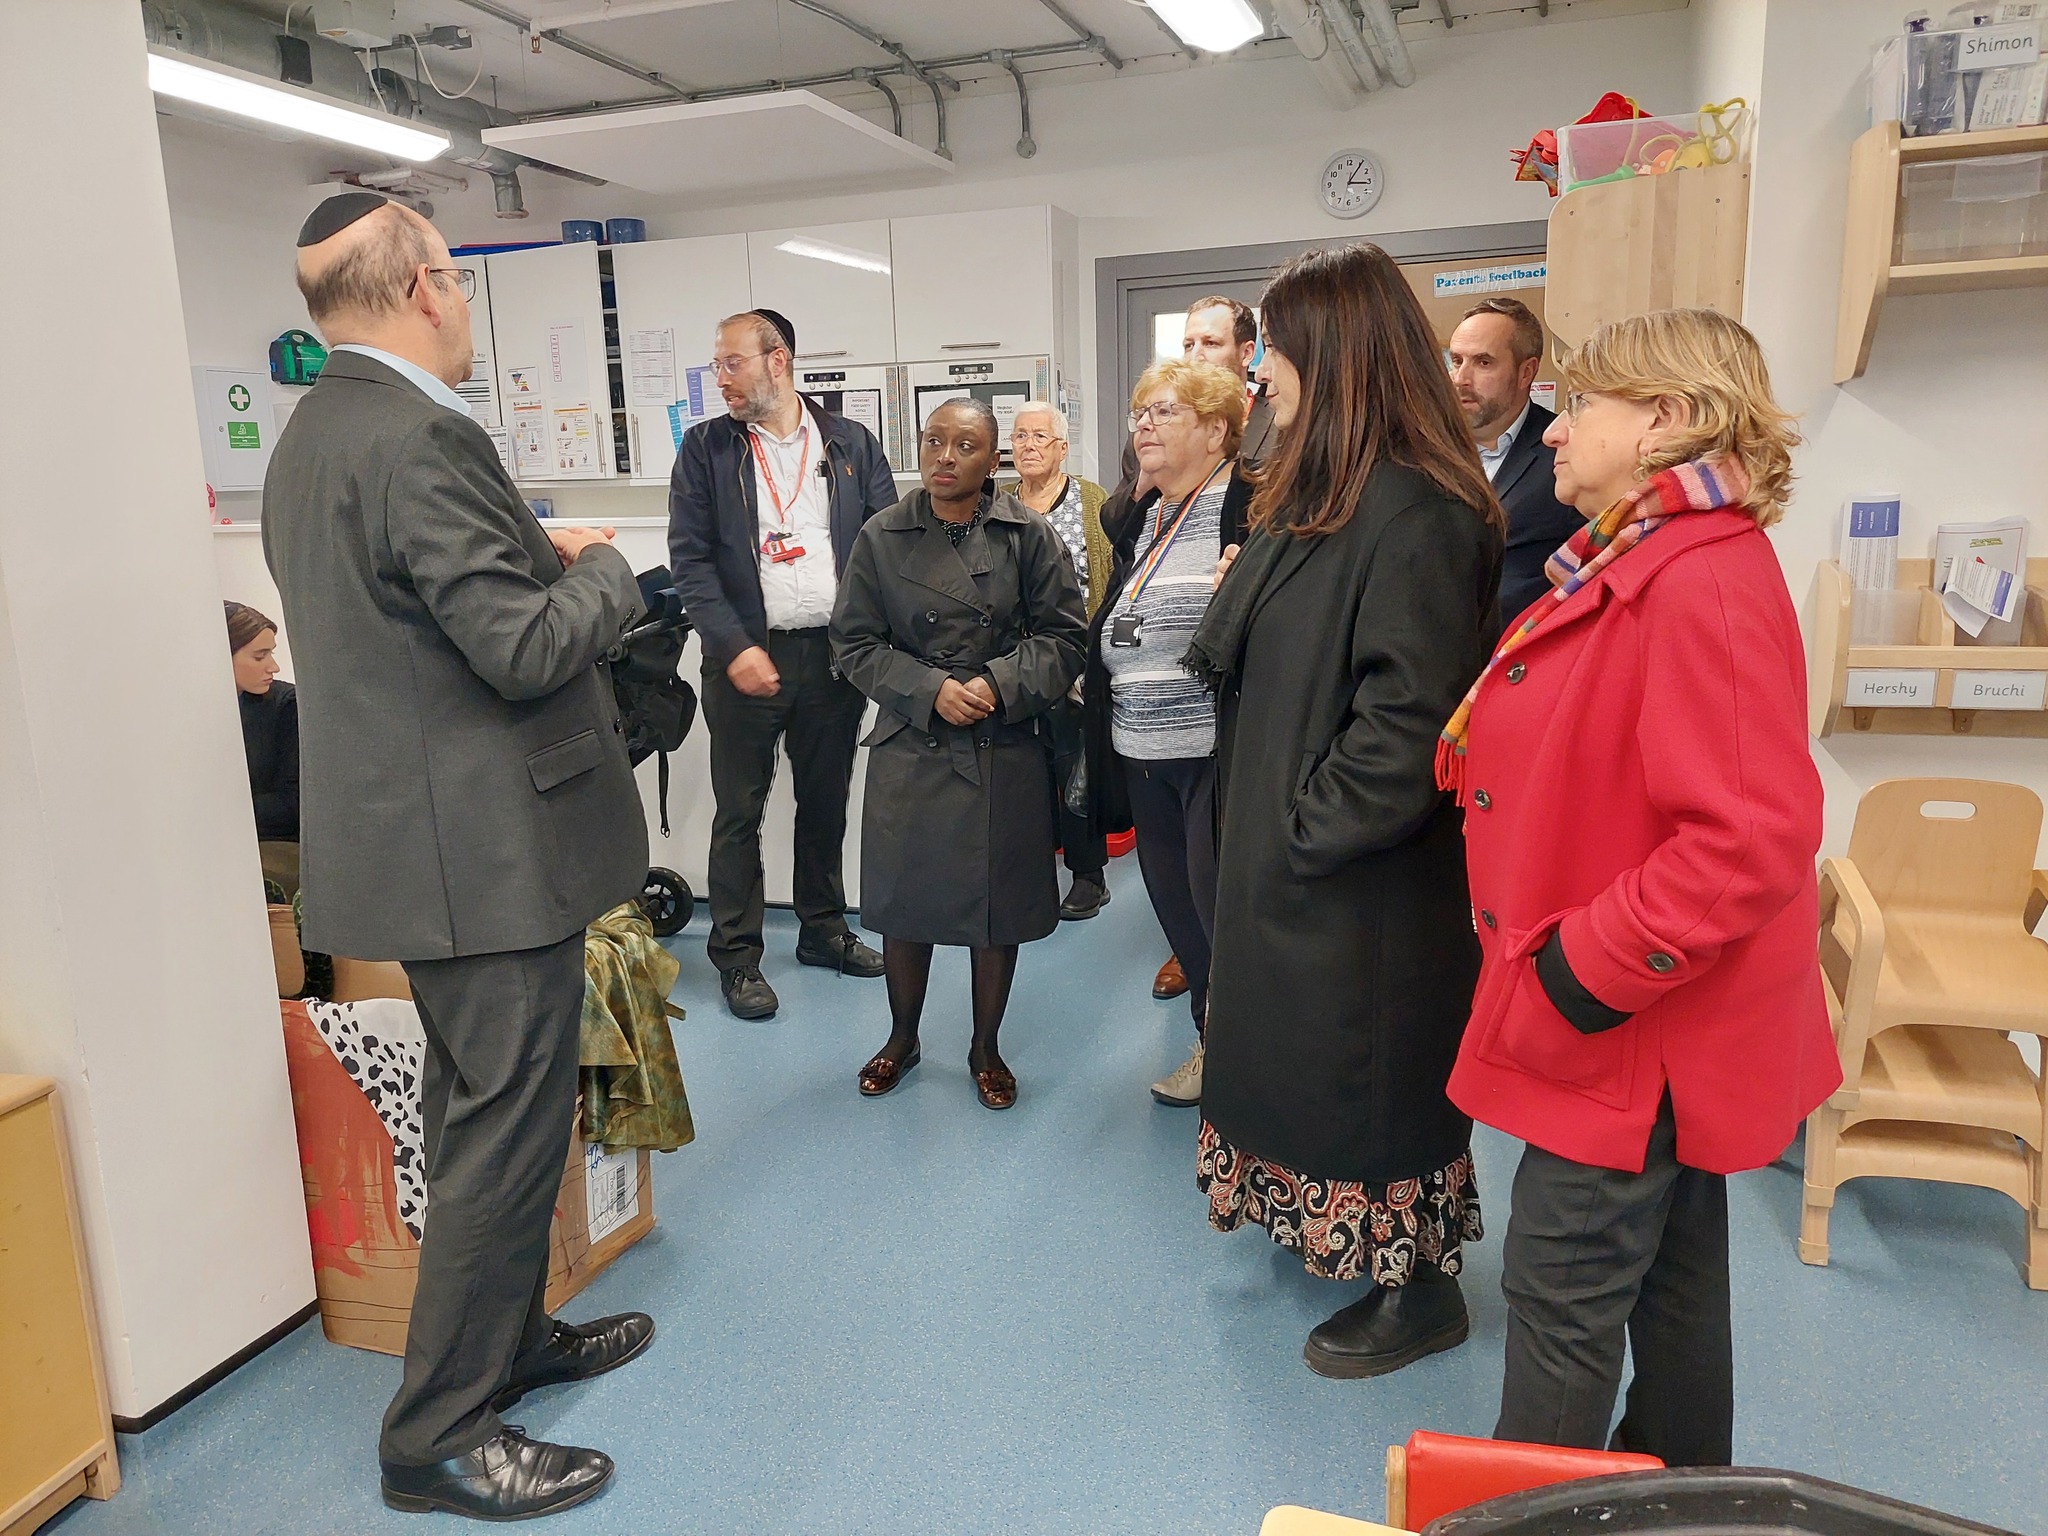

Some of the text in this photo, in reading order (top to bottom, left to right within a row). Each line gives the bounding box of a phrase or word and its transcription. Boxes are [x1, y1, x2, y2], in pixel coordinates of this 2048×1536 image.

[1965, 36, 2033, 55] Shimon
[1489, 267, 1547, 282] feedback
[1863, 681, 1917, 698] Hershy
[1973, 683, 2026, 697] Bruchi
